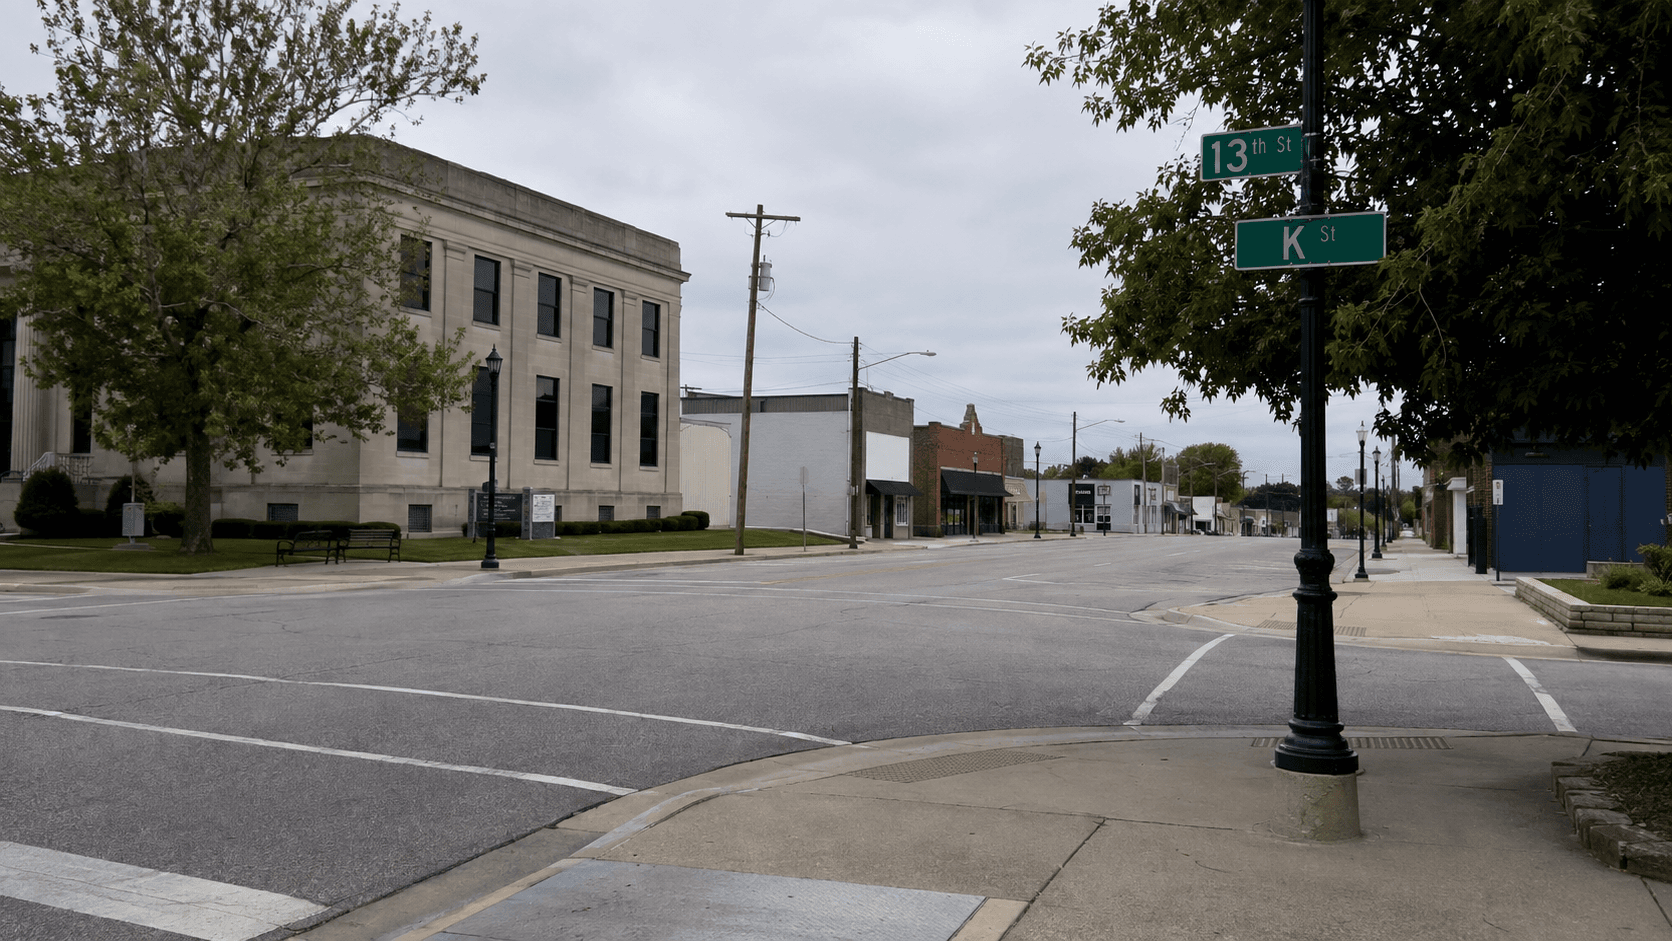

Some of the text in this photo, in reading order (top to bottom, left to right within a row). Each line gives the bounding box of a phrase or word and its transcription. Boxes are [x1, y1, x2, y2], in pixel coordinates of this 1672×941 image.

[1211, 135, 1292, 174] 13th St
[1282, 225, 1336, 261] K St
